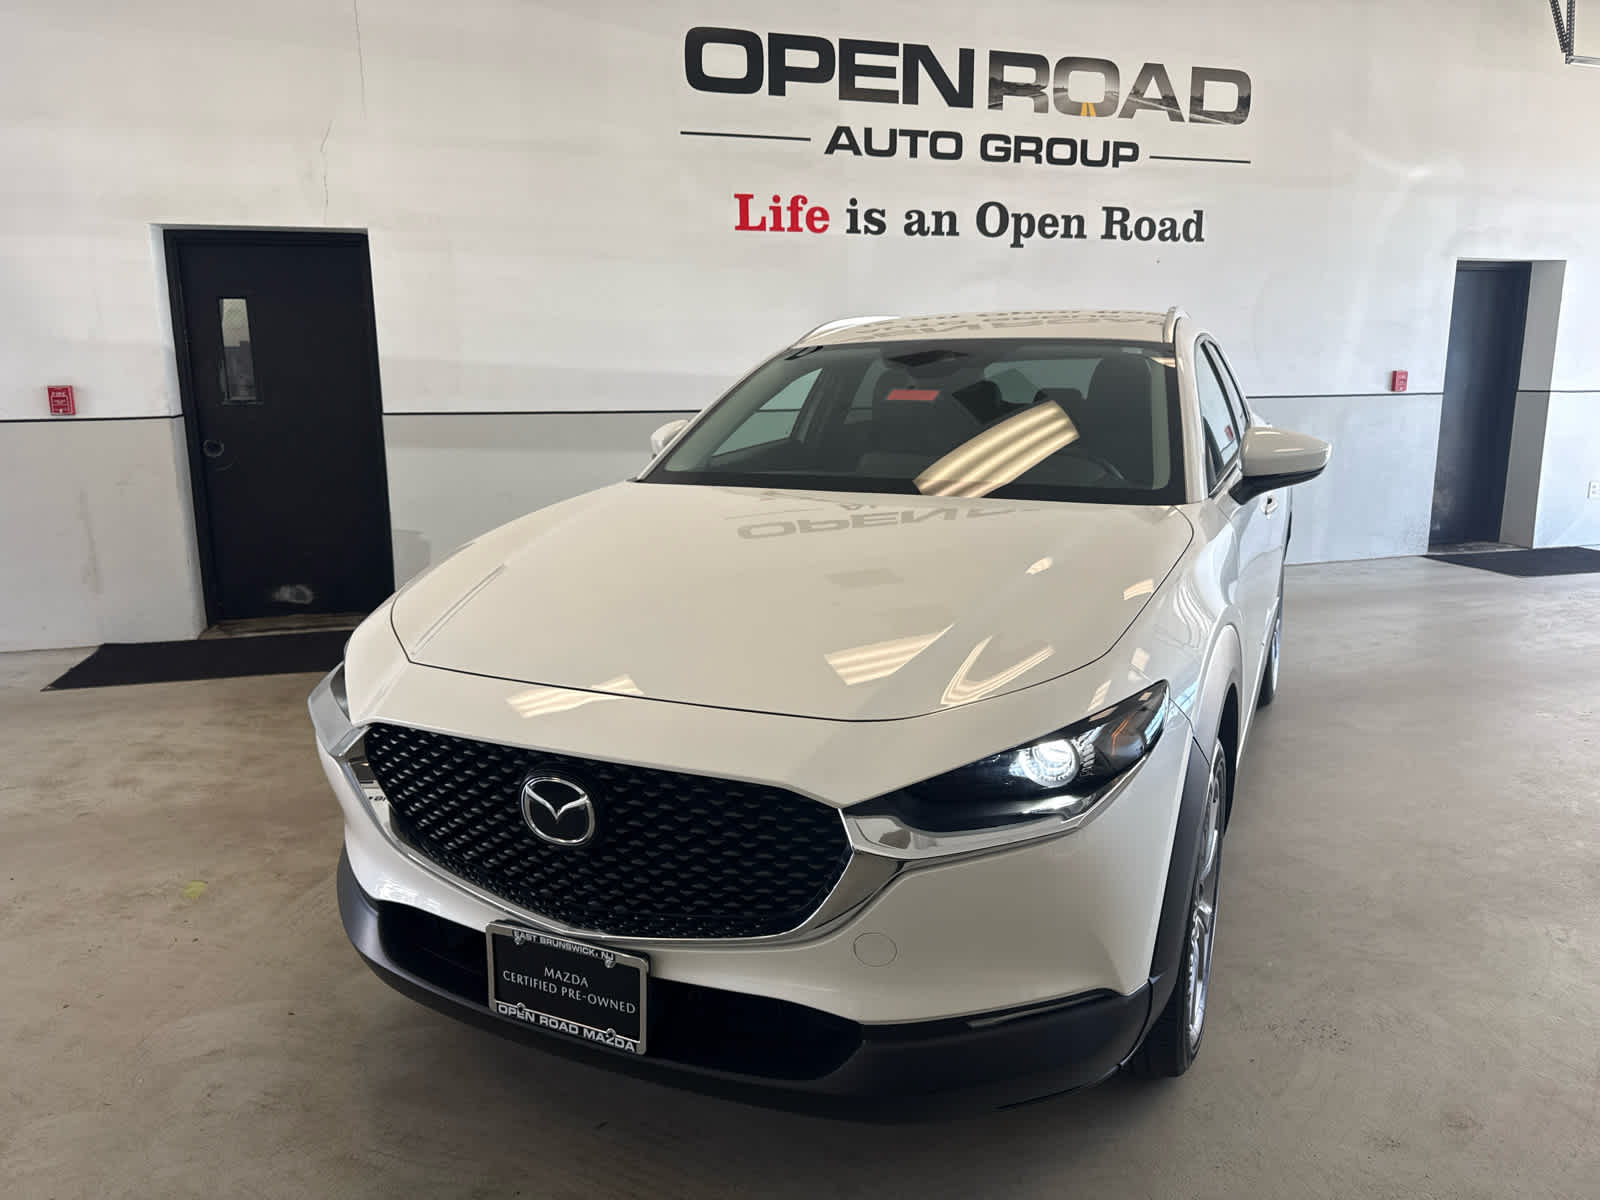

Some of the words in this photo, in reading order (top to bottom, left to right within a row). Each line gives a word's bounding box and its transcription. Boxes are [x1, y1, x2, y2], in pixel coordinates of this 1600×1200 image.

[684, 26, 975, 109] OPEN
[987, 49, 1252, 126] ROAD
[824, 125, 963, 160] AUTO
[979, 132, 1139, 168] GROUP
[733, 193, 830, 234] Life
[845, 198, 887, 235] is
[903, 206, 960, 237] an
[975, 200, 1087, 248] Open
[1100, 206, 1205, 243] Road
[513, 930, 537, 942] EAST
[503, 970, 558, 994] CERTIFIED
[561, 987, 636, 1014] PRE-OWNED
[544, 967, 589, 988] MAZDA
[498, 1004, 535, 1023] OPEN
[539, 1015, 579, 1034] ROAD
[583, 1028, 636, 1052] MAZDA
